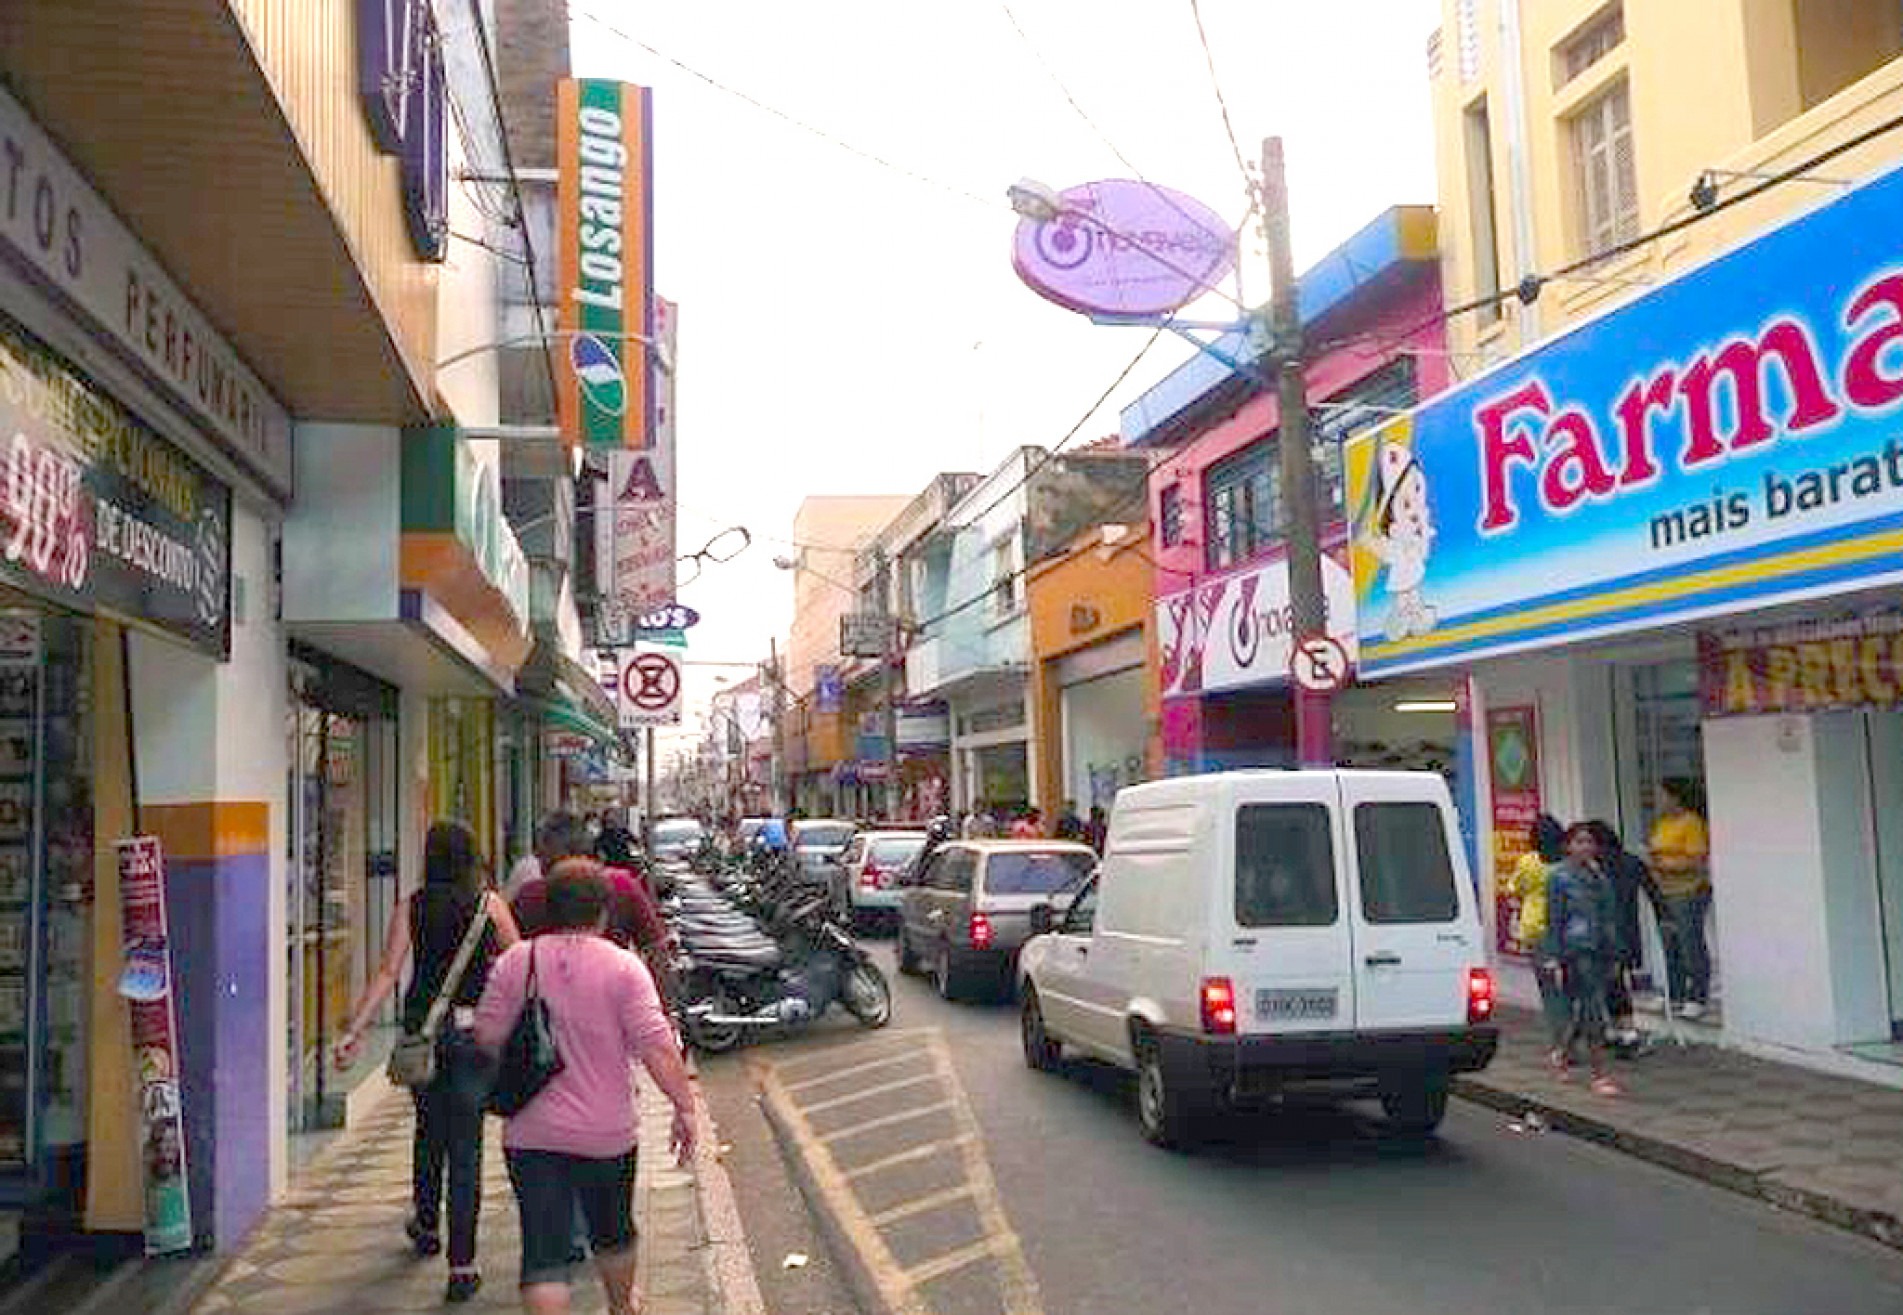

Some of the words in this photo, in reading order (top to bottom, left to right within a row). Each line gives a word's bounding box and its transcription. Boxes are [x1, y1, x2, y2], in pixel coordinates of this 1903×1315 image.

[571, 107, 627, 310] Losango
[1477, 272, 1903, 530] Farma
[1651, 486, 1749, 549] mais
